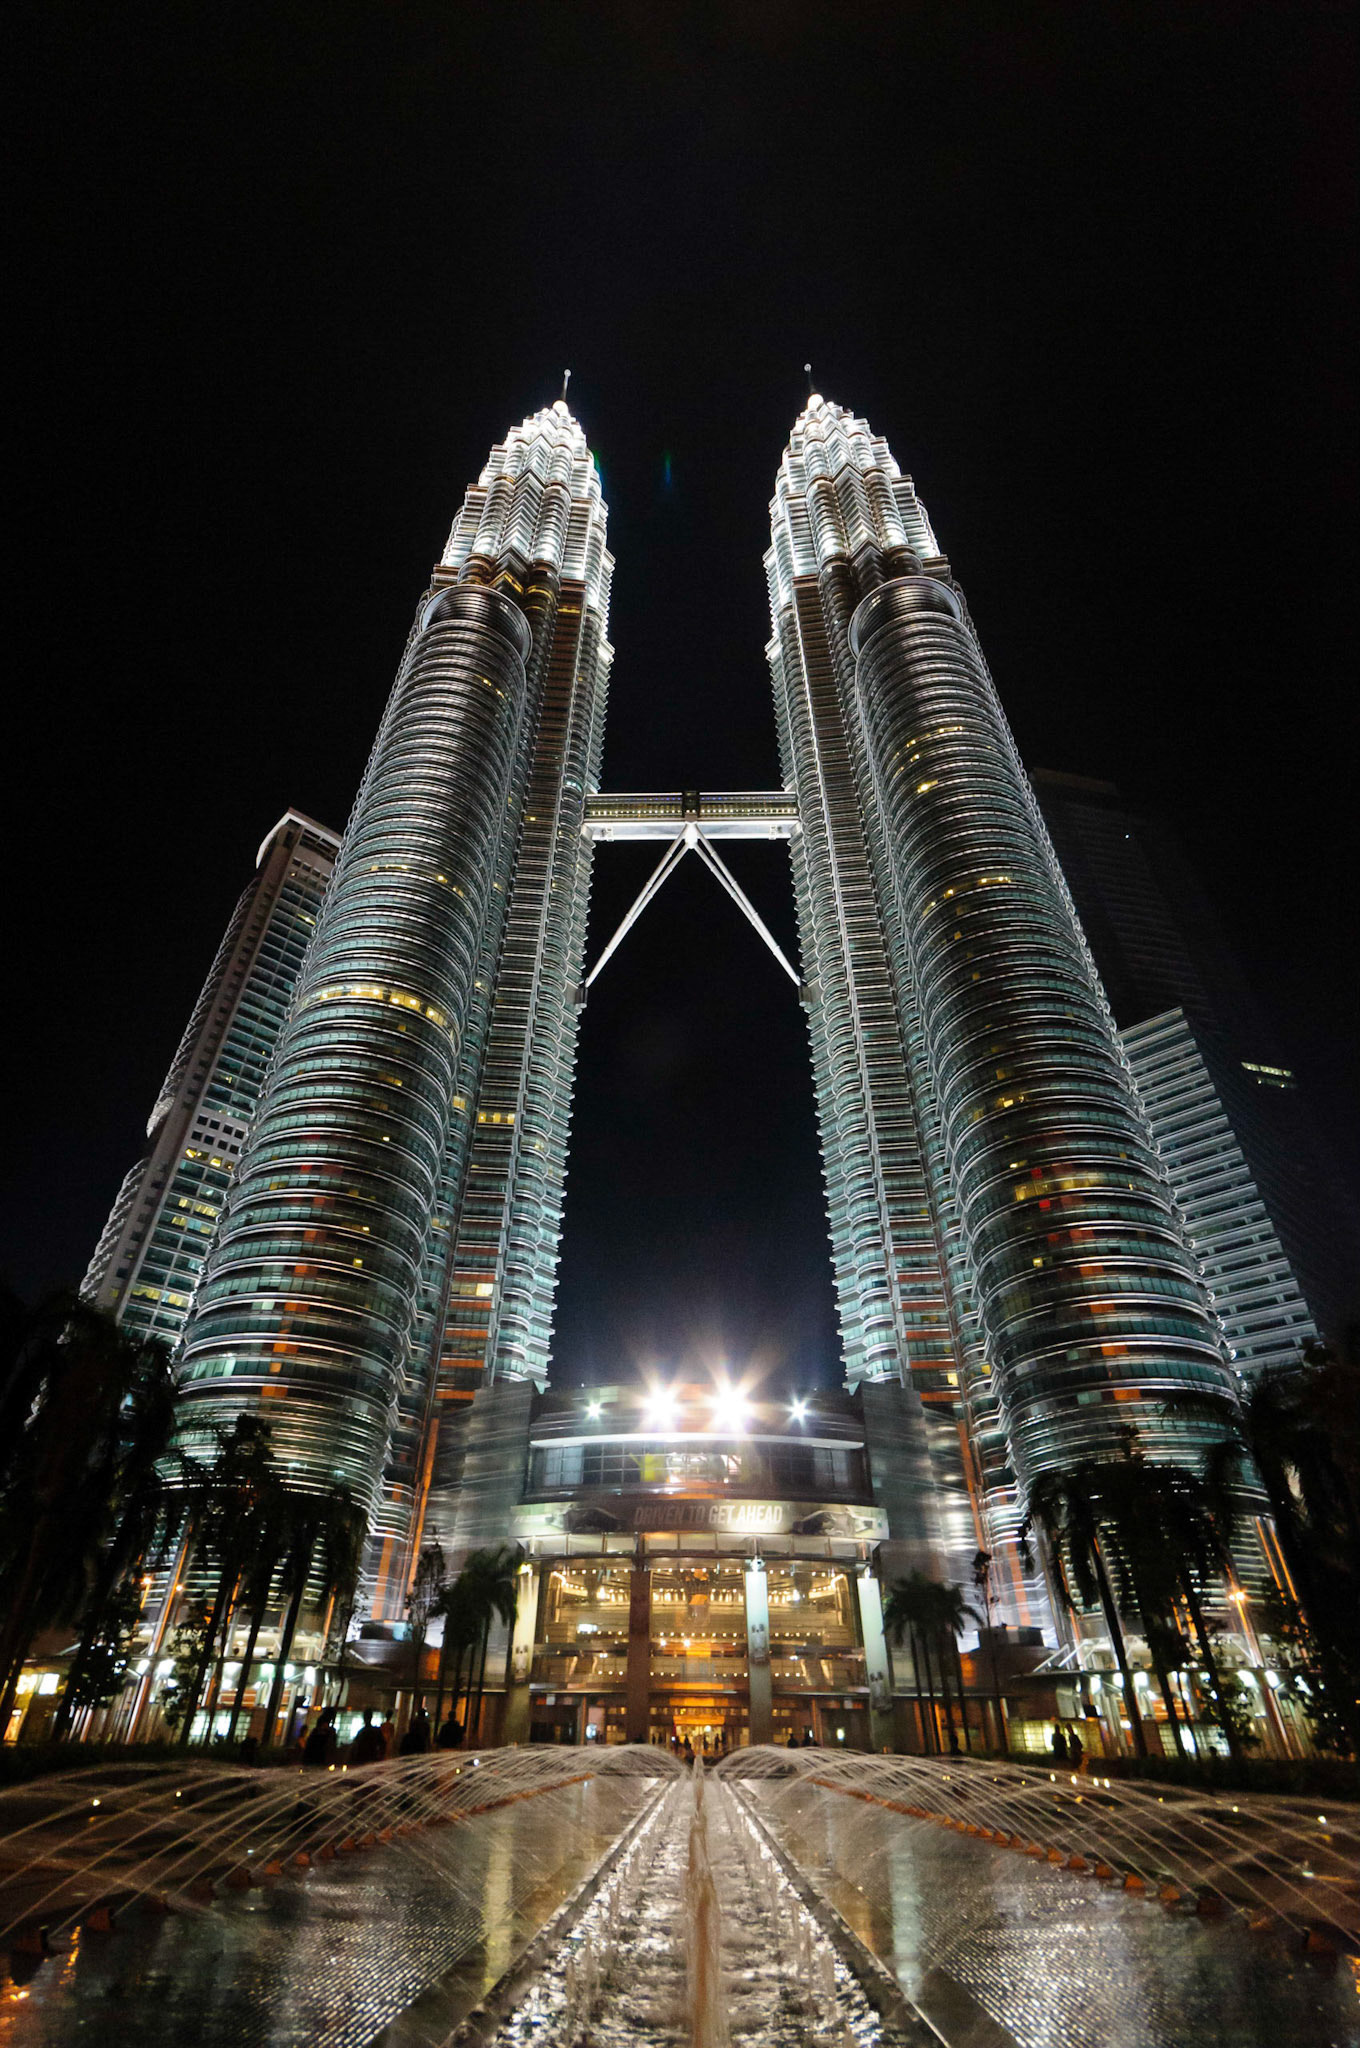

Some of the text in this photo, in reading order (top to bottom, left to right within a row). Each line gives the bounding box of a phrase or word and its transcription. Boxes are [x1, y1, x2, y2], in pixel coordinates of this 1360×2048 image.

[633, 1505, 783, 1525] DRIVEN TO GET AHEAD
